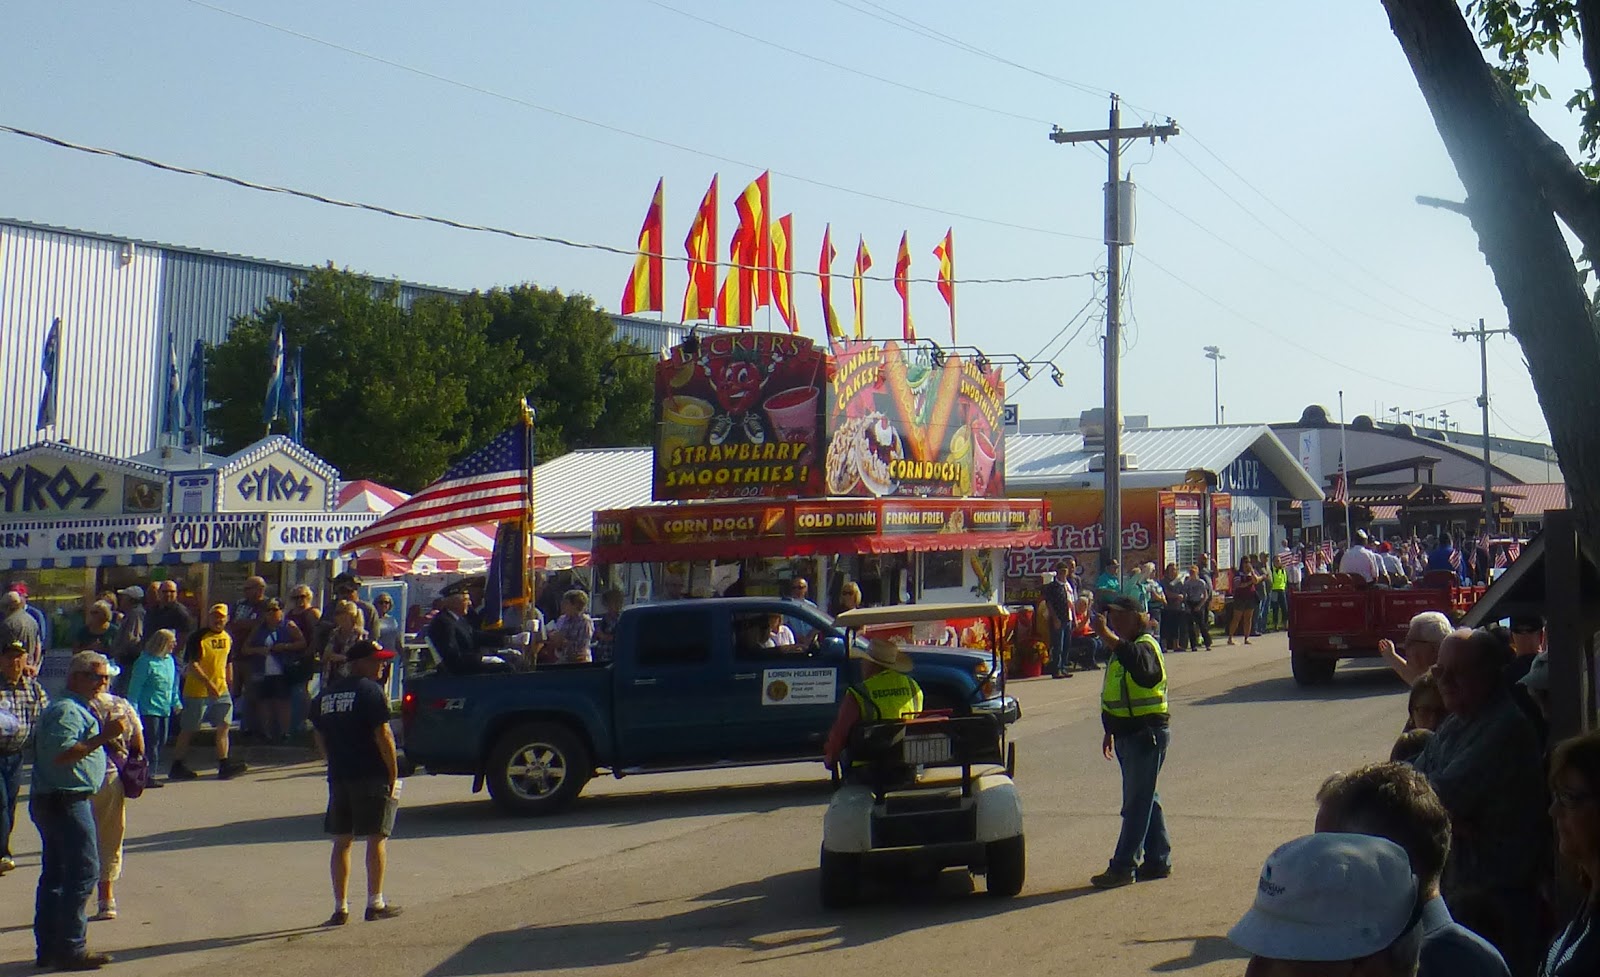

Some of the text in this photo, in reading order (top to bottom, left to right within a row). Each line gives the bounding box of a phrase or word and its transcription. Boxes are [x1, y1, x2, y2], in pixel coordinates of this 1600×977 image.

[832, 345, 880, 394] FUNNEL
[838, 366, 879, 411] CAKES!
[965, 361, 1004, 417] STRAWBERRY
[961, 380, 998, 431] SMOOTHIES!
[672, 442, 807, 466] STRAWBERRY
[889, 459, 961, 481] CORN DOGS!
[1229, 459, 1260, 490] CAFE
[0, 464, 108, 512] YROS
[237, 464, 313, 502] GYROS
[663, 516, 755, 534] CORN DOGS
[798, 510, 877, 528] COLD DRINKS
[886, 511, 945, 525] FRENCH FRIES
[973, 511, 1001, 523] CHICKEN
[1008, 511, 1026, 523] FRIES
[56, 531, 104, 551] GREEK
[172, 521, 262, 550] COLD DRINKS
[280, 526, 323, 544] GREEK
[211, 638, 227, 649] CAT
[872, 687, 911, 699] SECURITY
